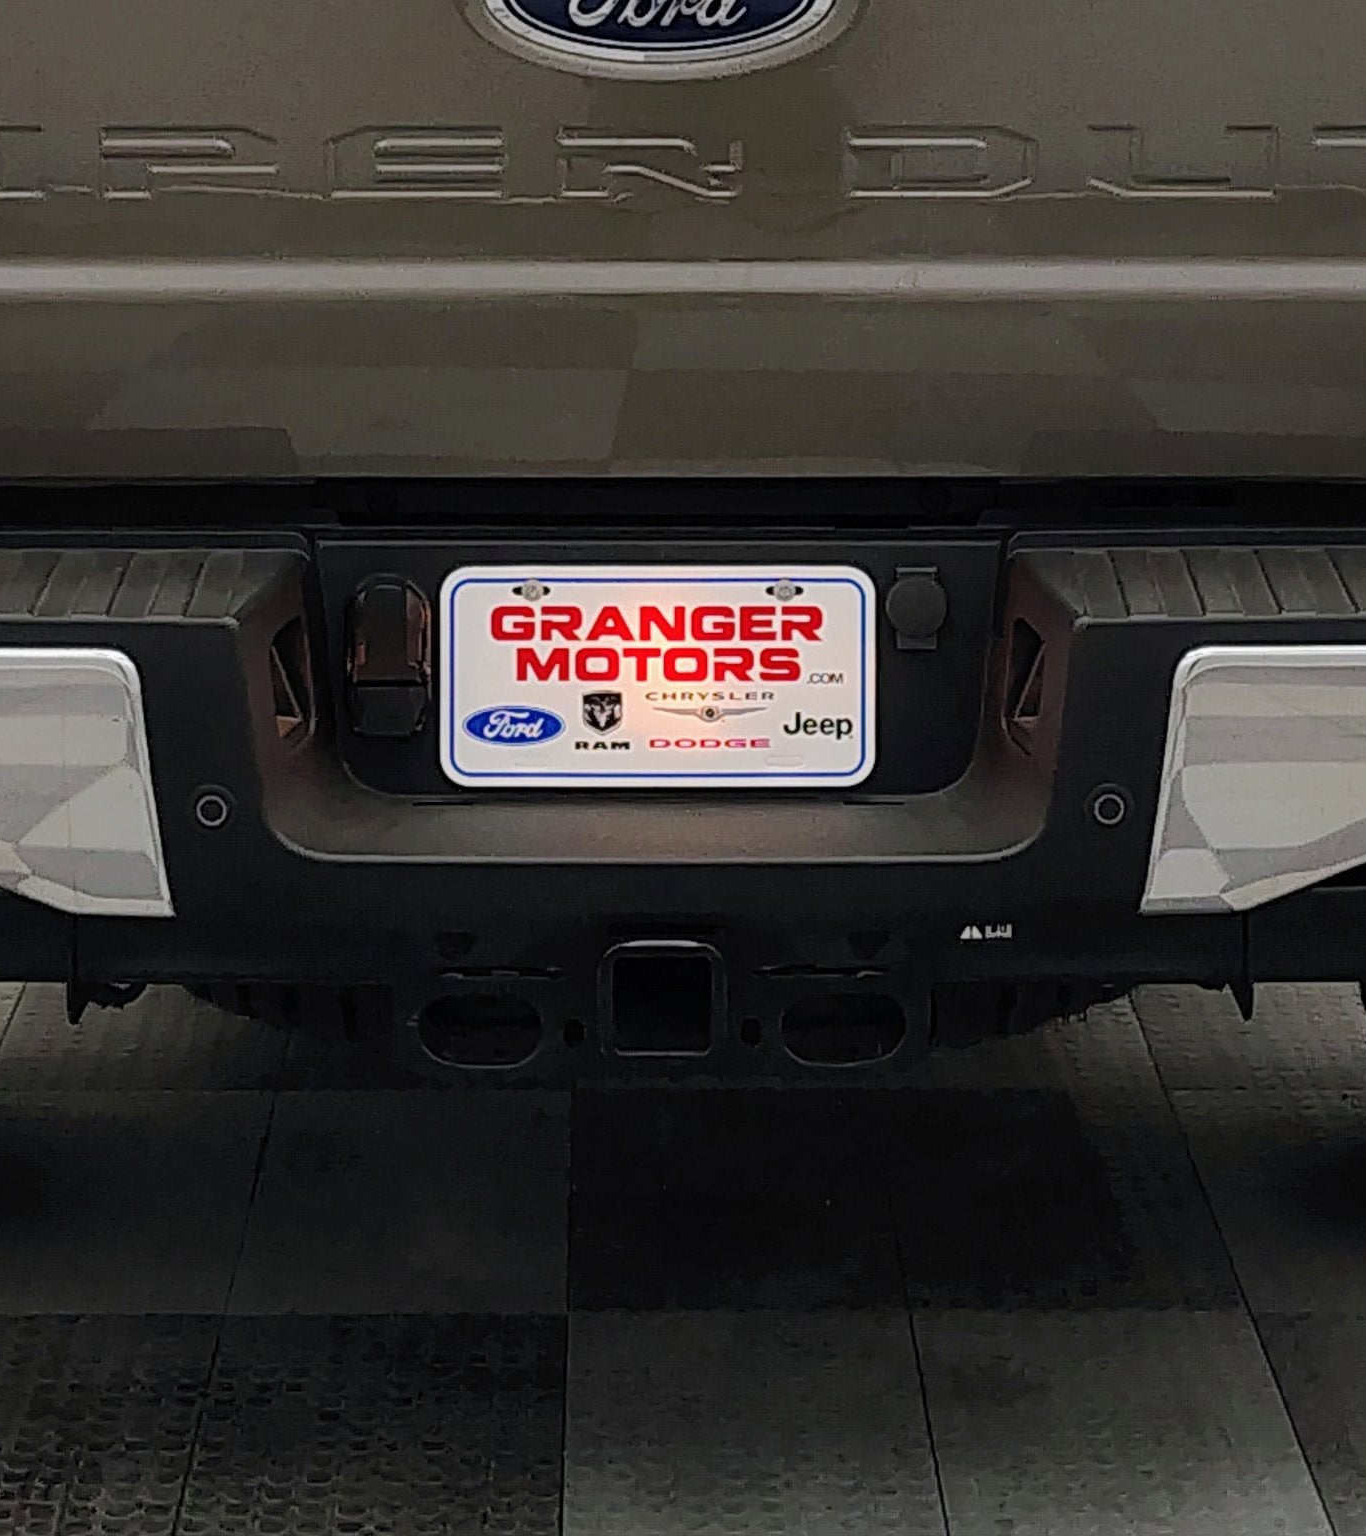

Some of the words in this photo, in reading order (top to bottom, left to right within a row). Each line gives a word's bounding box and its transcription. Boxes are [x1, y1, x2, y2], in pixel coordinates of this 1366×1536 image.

[490, 606, 823, 642] GRANGER
[516, 647, 801, 683] MOTORS
[806, 672, 844, 684] .COM
[645, 691, 775, 701] CHRYSLER
[483, 710, 544, 739] Ford
[783, 711, 853, 740] Jeep
[574, 741, 631, 750] RAM
[649, 738, 771, 748] DODGE
